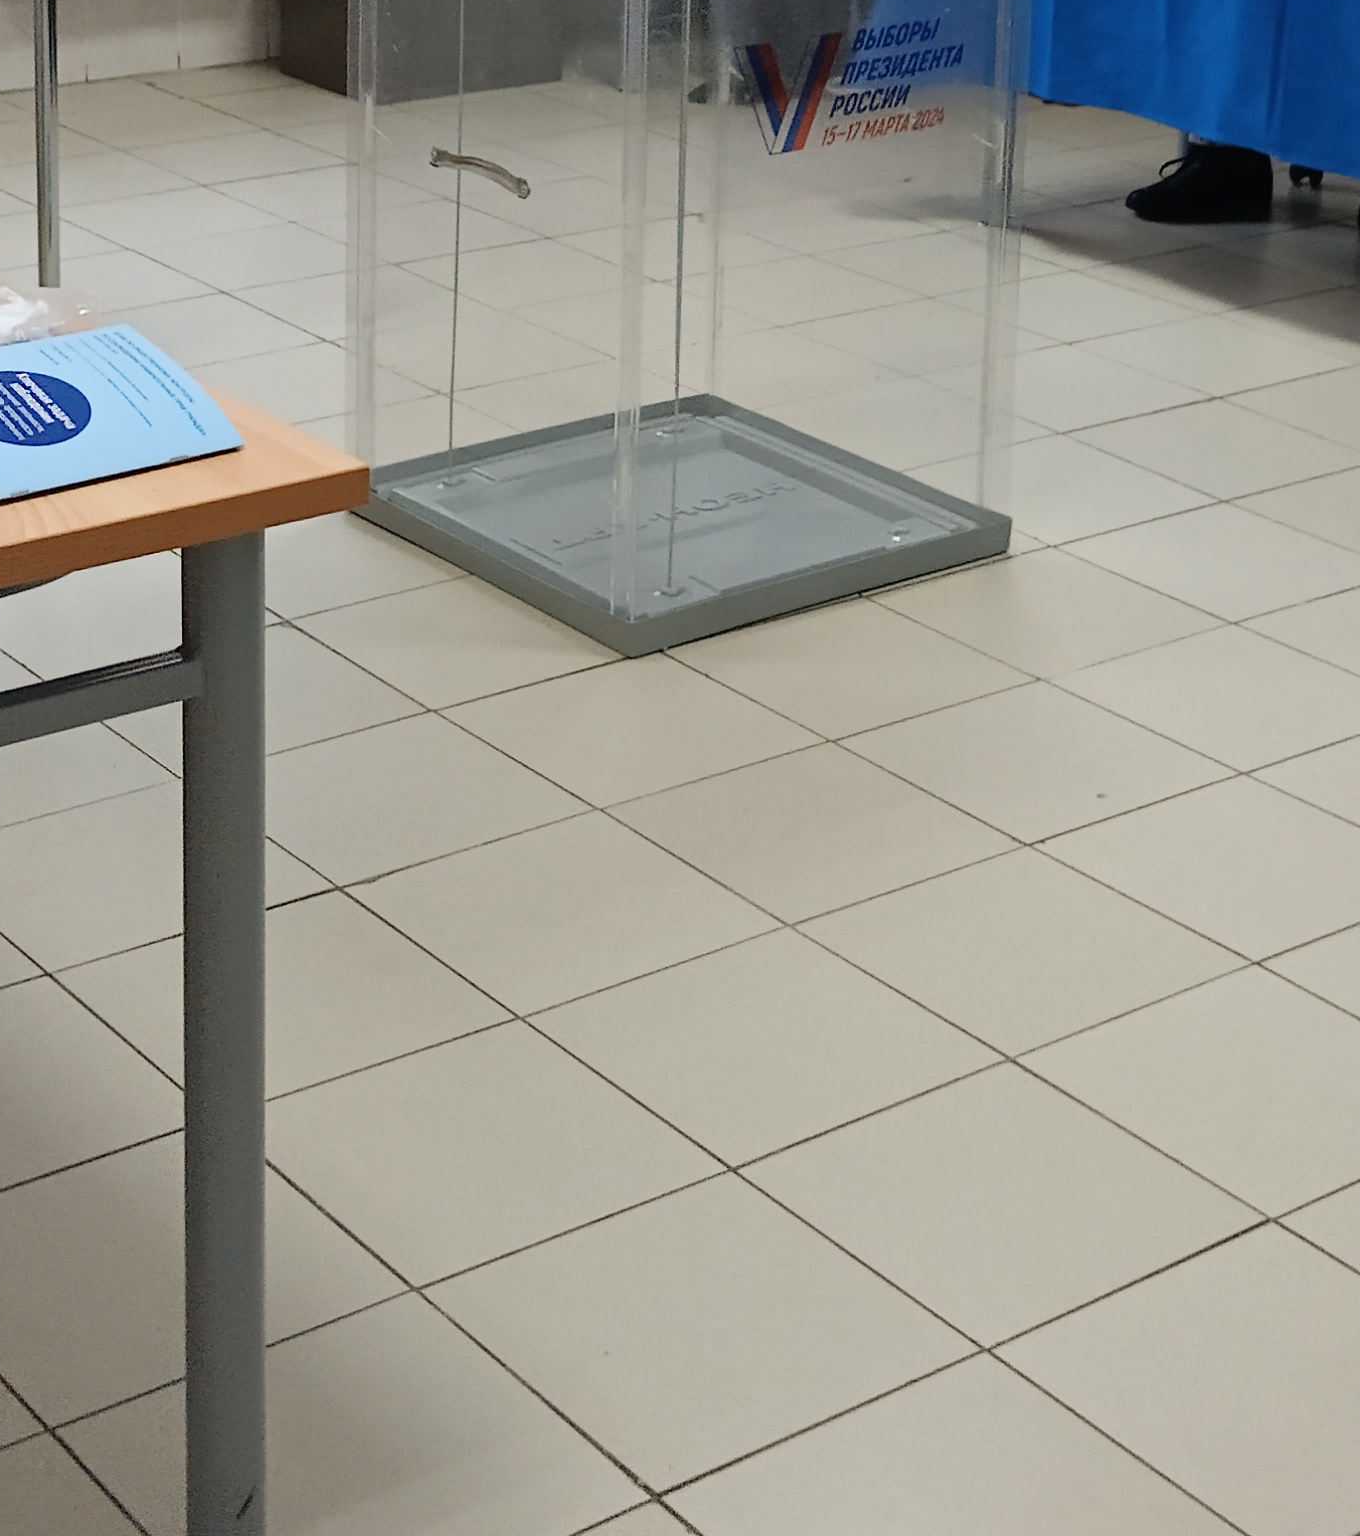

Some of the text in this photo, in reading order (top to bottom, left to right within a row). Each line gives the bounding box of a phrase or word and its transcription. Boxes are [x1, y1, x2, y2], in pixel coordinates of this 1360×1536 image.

[851, 17, 941, 53] ВЫБОРЫ
[839, 44, 965, 86] ПРЕЗИДЕНТА
[829, 83, 912, 119] РОССИИ
[861, 114, 912, 141] МАРТА
